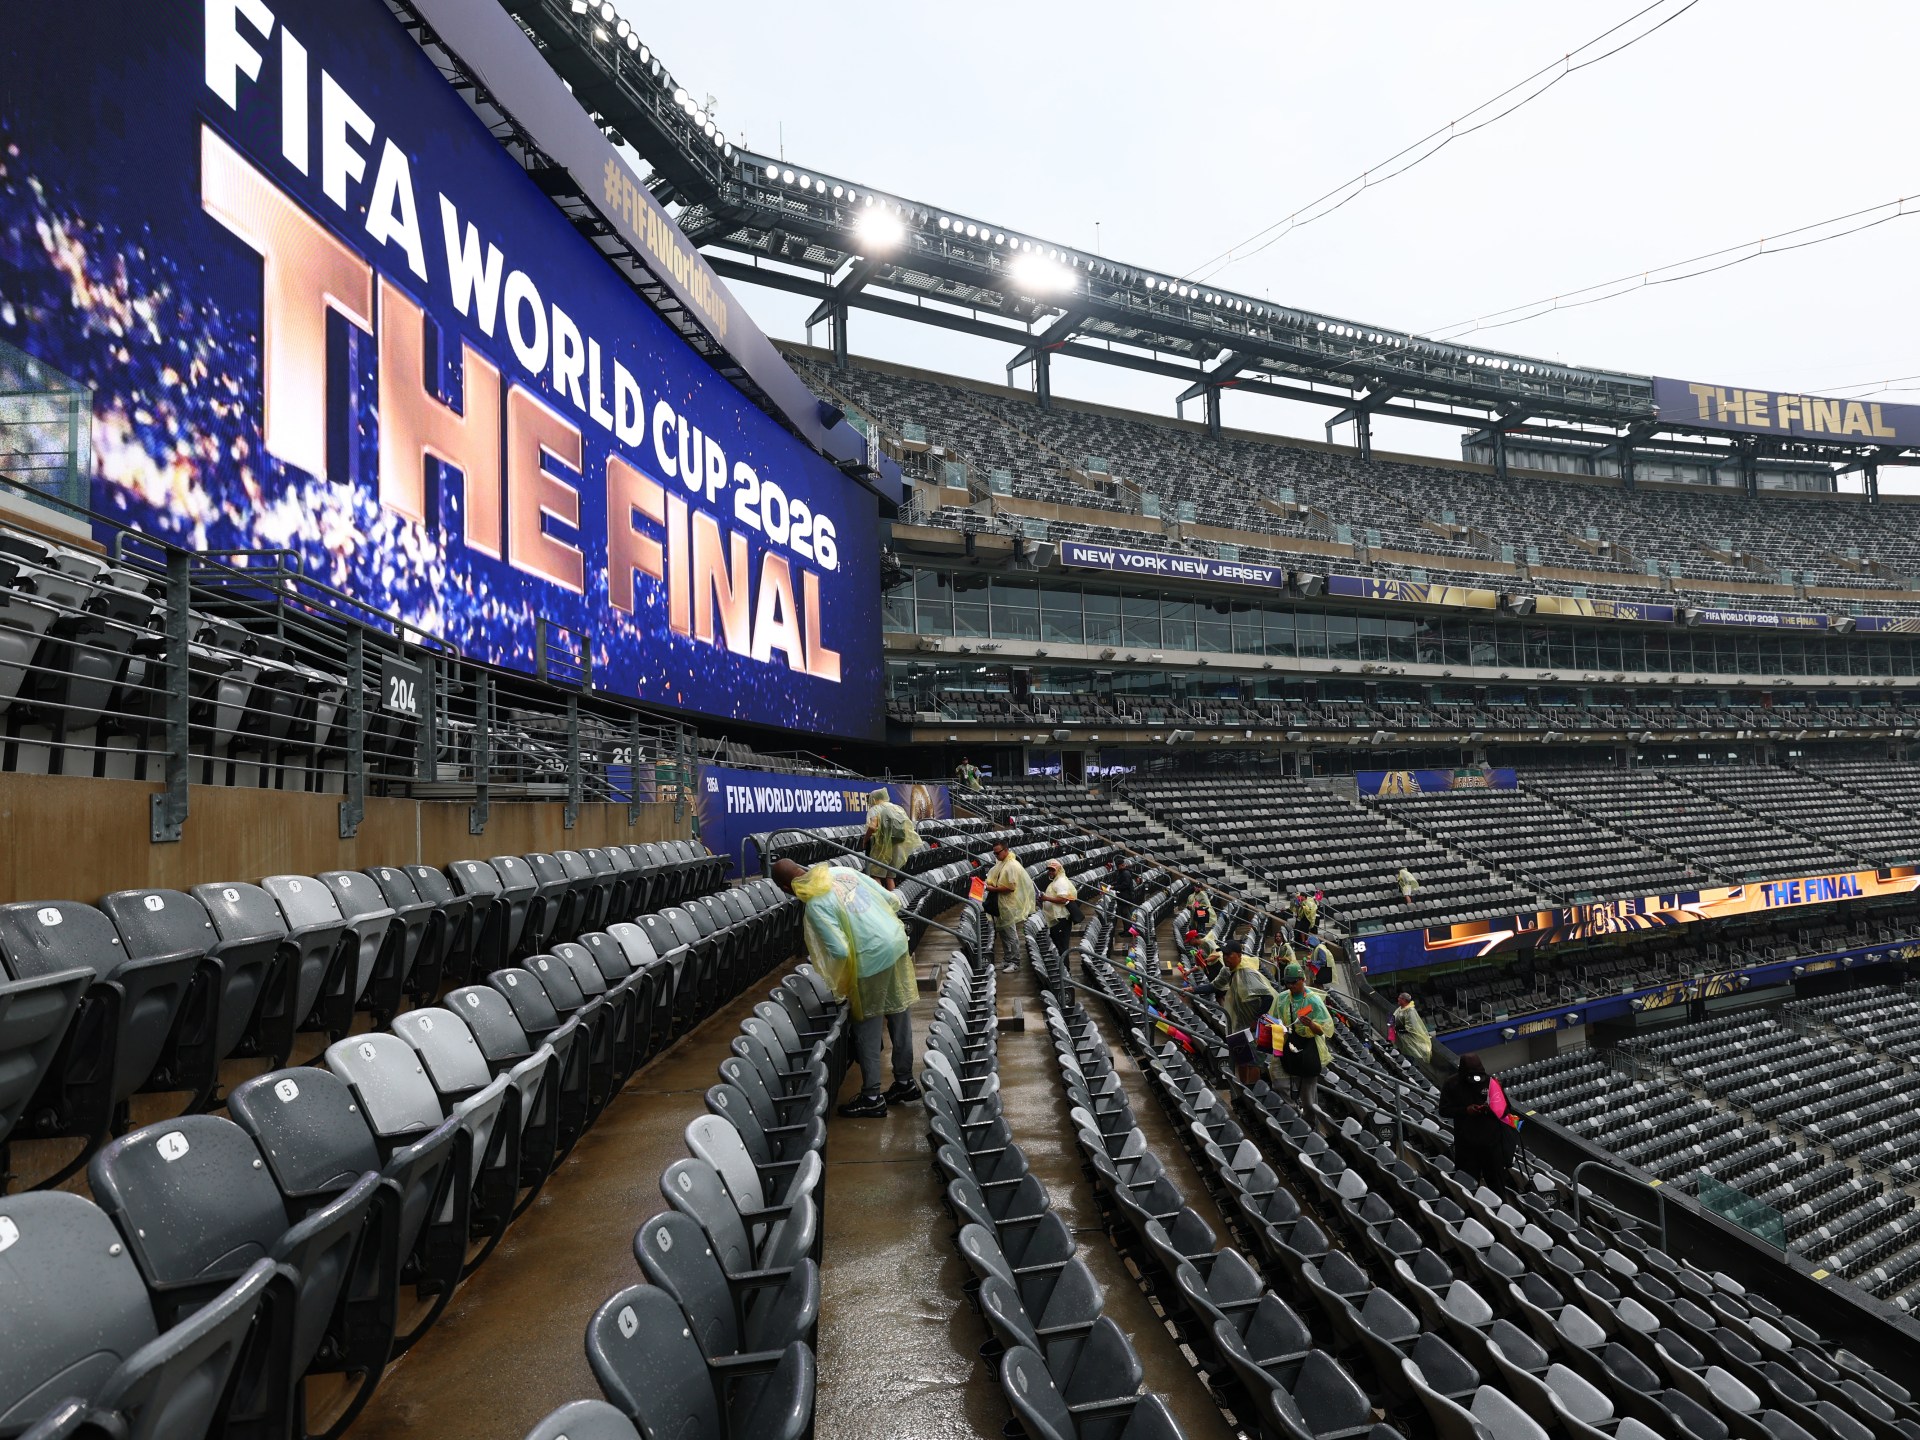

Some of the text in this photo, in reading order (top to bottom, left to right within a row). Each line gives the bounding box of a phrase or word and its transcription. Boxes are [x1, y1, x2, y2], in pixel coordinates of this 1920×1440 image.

[603, 158, 727, 338] #FIFAWorldCup
[205, 0, 838, 571] FIFA WORLD CUP 2026
[201, 122, 841, 684] THE FINAL
[1689, 383, 1896, 438] THE FINAL
[1073, 548, 1273, 582] NEW YORK NEW JERSEY
[1705, 611, 1819, 626] FIFA WORLD CUP 2026 THE FINAL
[390, 675, 416, 713] 204
[725, 785, 754, 814] FIFA
[754, 786, 795, 813] WORLD
[795, 789, 813, 813] CUP
[815, 790, 842, 812] 2026
[842, 790, 860, 812] THE
[1760, 874, 1864, 907] THE FINAL
